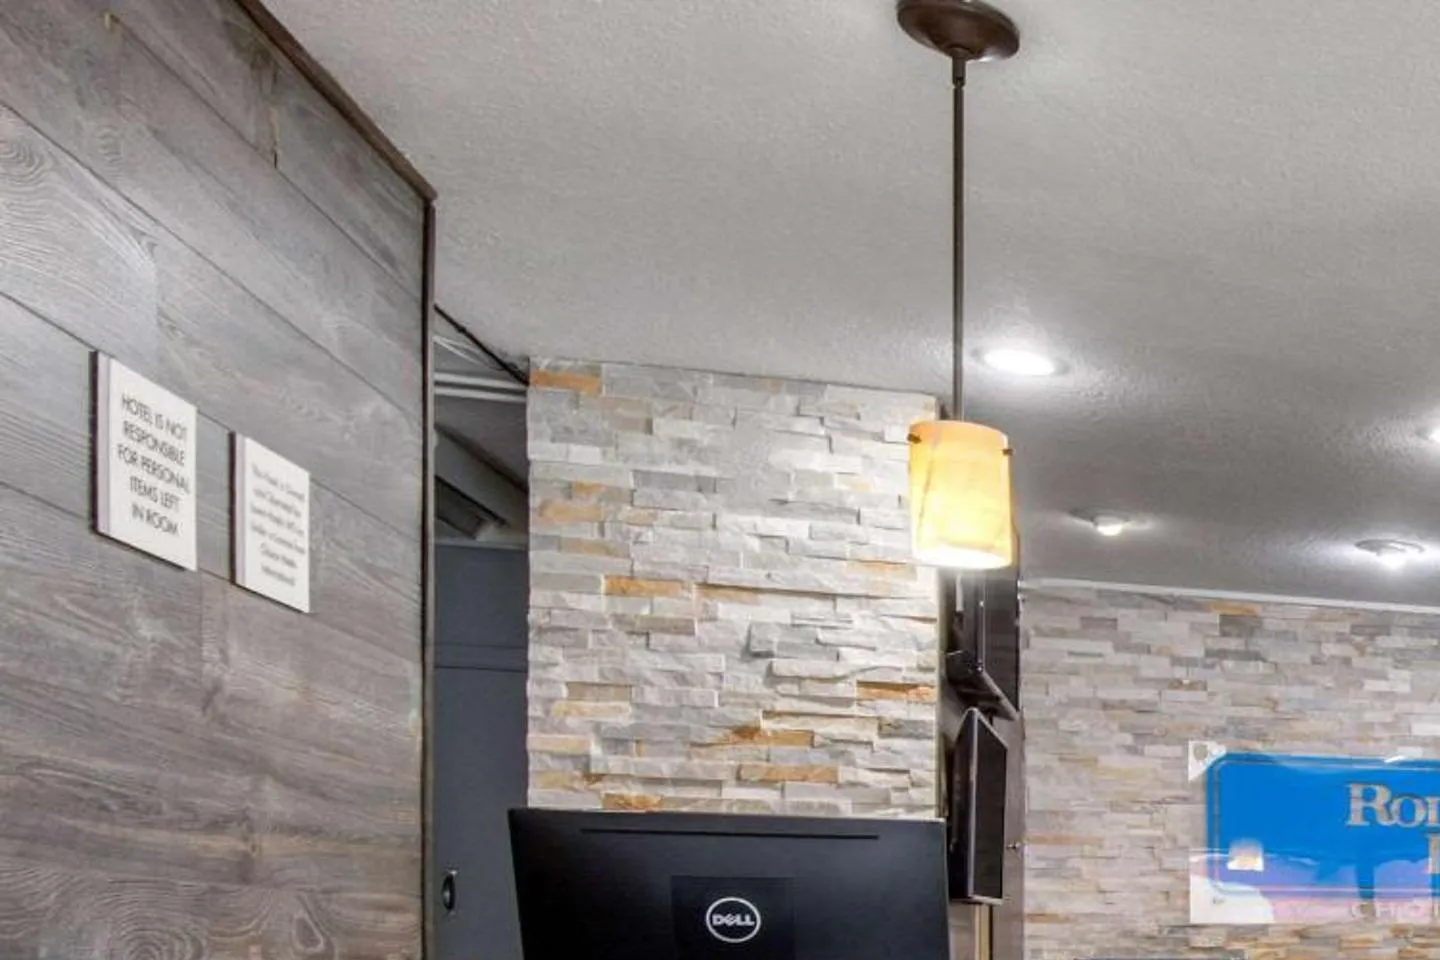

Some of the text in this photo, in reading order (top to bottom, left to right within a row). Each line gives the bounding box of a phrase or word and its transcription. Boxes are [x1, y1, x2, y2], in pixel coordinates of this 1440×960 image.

[122, 394, 187, 442] HOTEL IS NOT
[123, 420, 185, 467] RESPONSIBLE
[117, 444, 191, 495] FOR PERSONAL
[129, 475, 180, 513] ITEMS LEFT
[131, 501, 178, 536] IN ROOM
[711, 913, 755, 926] DELL
